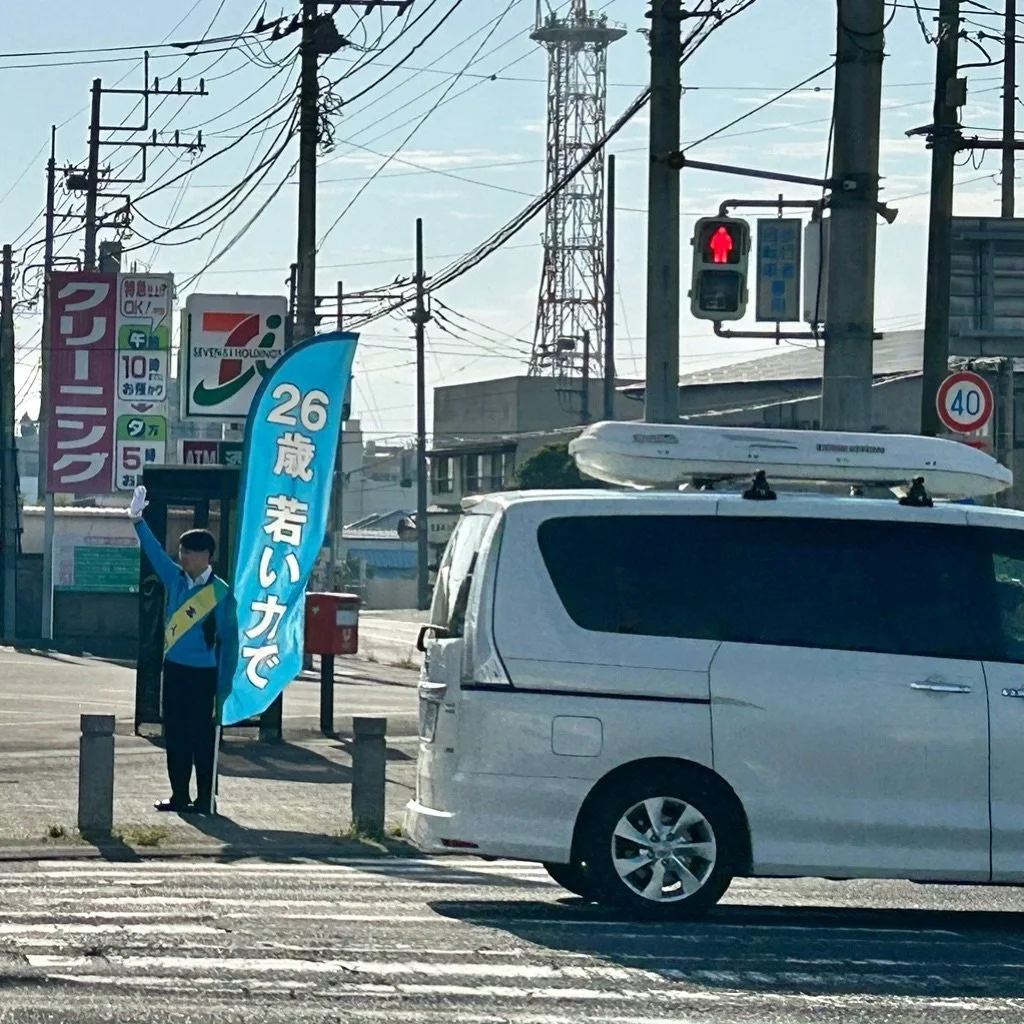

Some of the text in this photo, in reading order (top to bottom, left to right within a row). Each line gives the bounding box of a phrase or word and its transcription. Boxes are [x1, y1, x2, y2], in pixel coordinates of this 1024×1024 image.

[53, 282, 110, 483] クリーニング
[951, 389, 980, 416] 40
[185, 450, 217, 464] ATM
[241, 383, 330, 690] 26歳 若い力で
